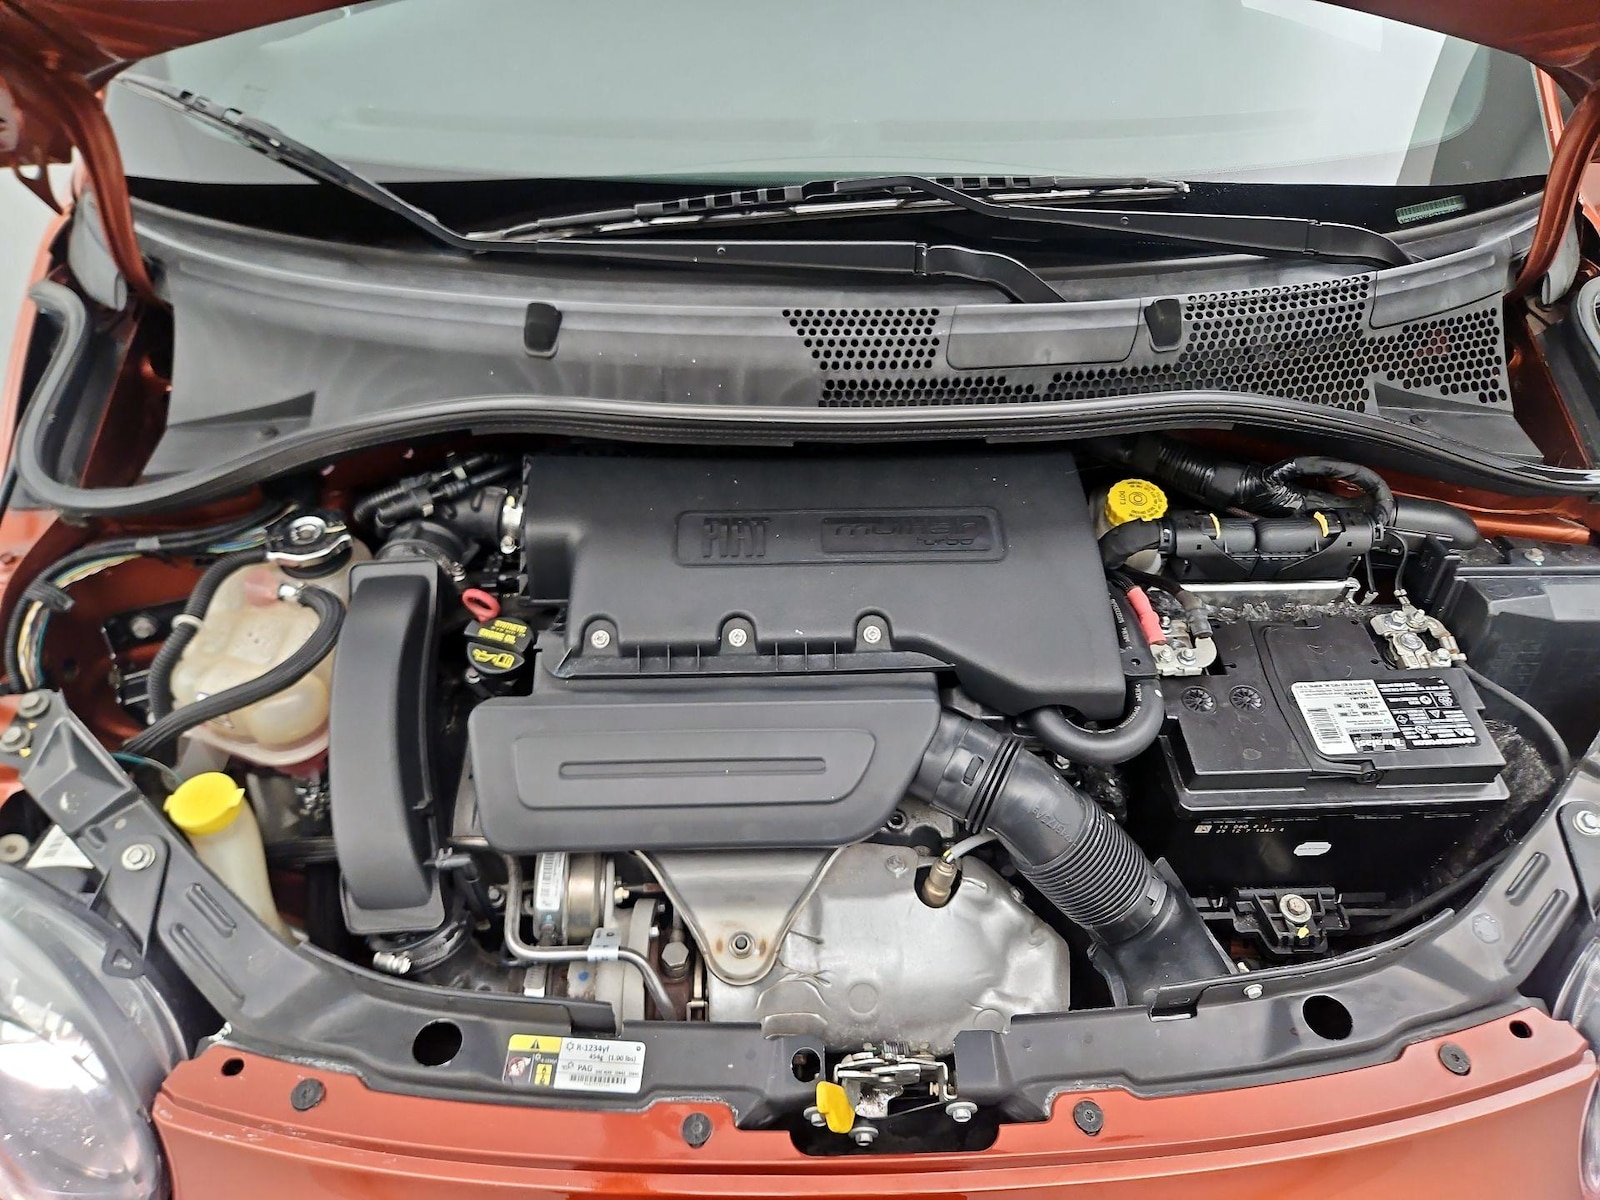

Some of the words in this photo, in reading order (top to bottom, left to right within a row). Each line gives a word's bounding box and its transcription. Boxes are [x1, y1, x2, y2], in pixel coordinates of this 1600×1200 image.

[703, 516, 771, 558] FIAT
[1353, 737, 1406, 749] Duralast
[576, 1043, 610, 1053] R-1234yf
[589, 1053, 604, 1062] 454g
[577, 1064, 593, 1072] PAG
